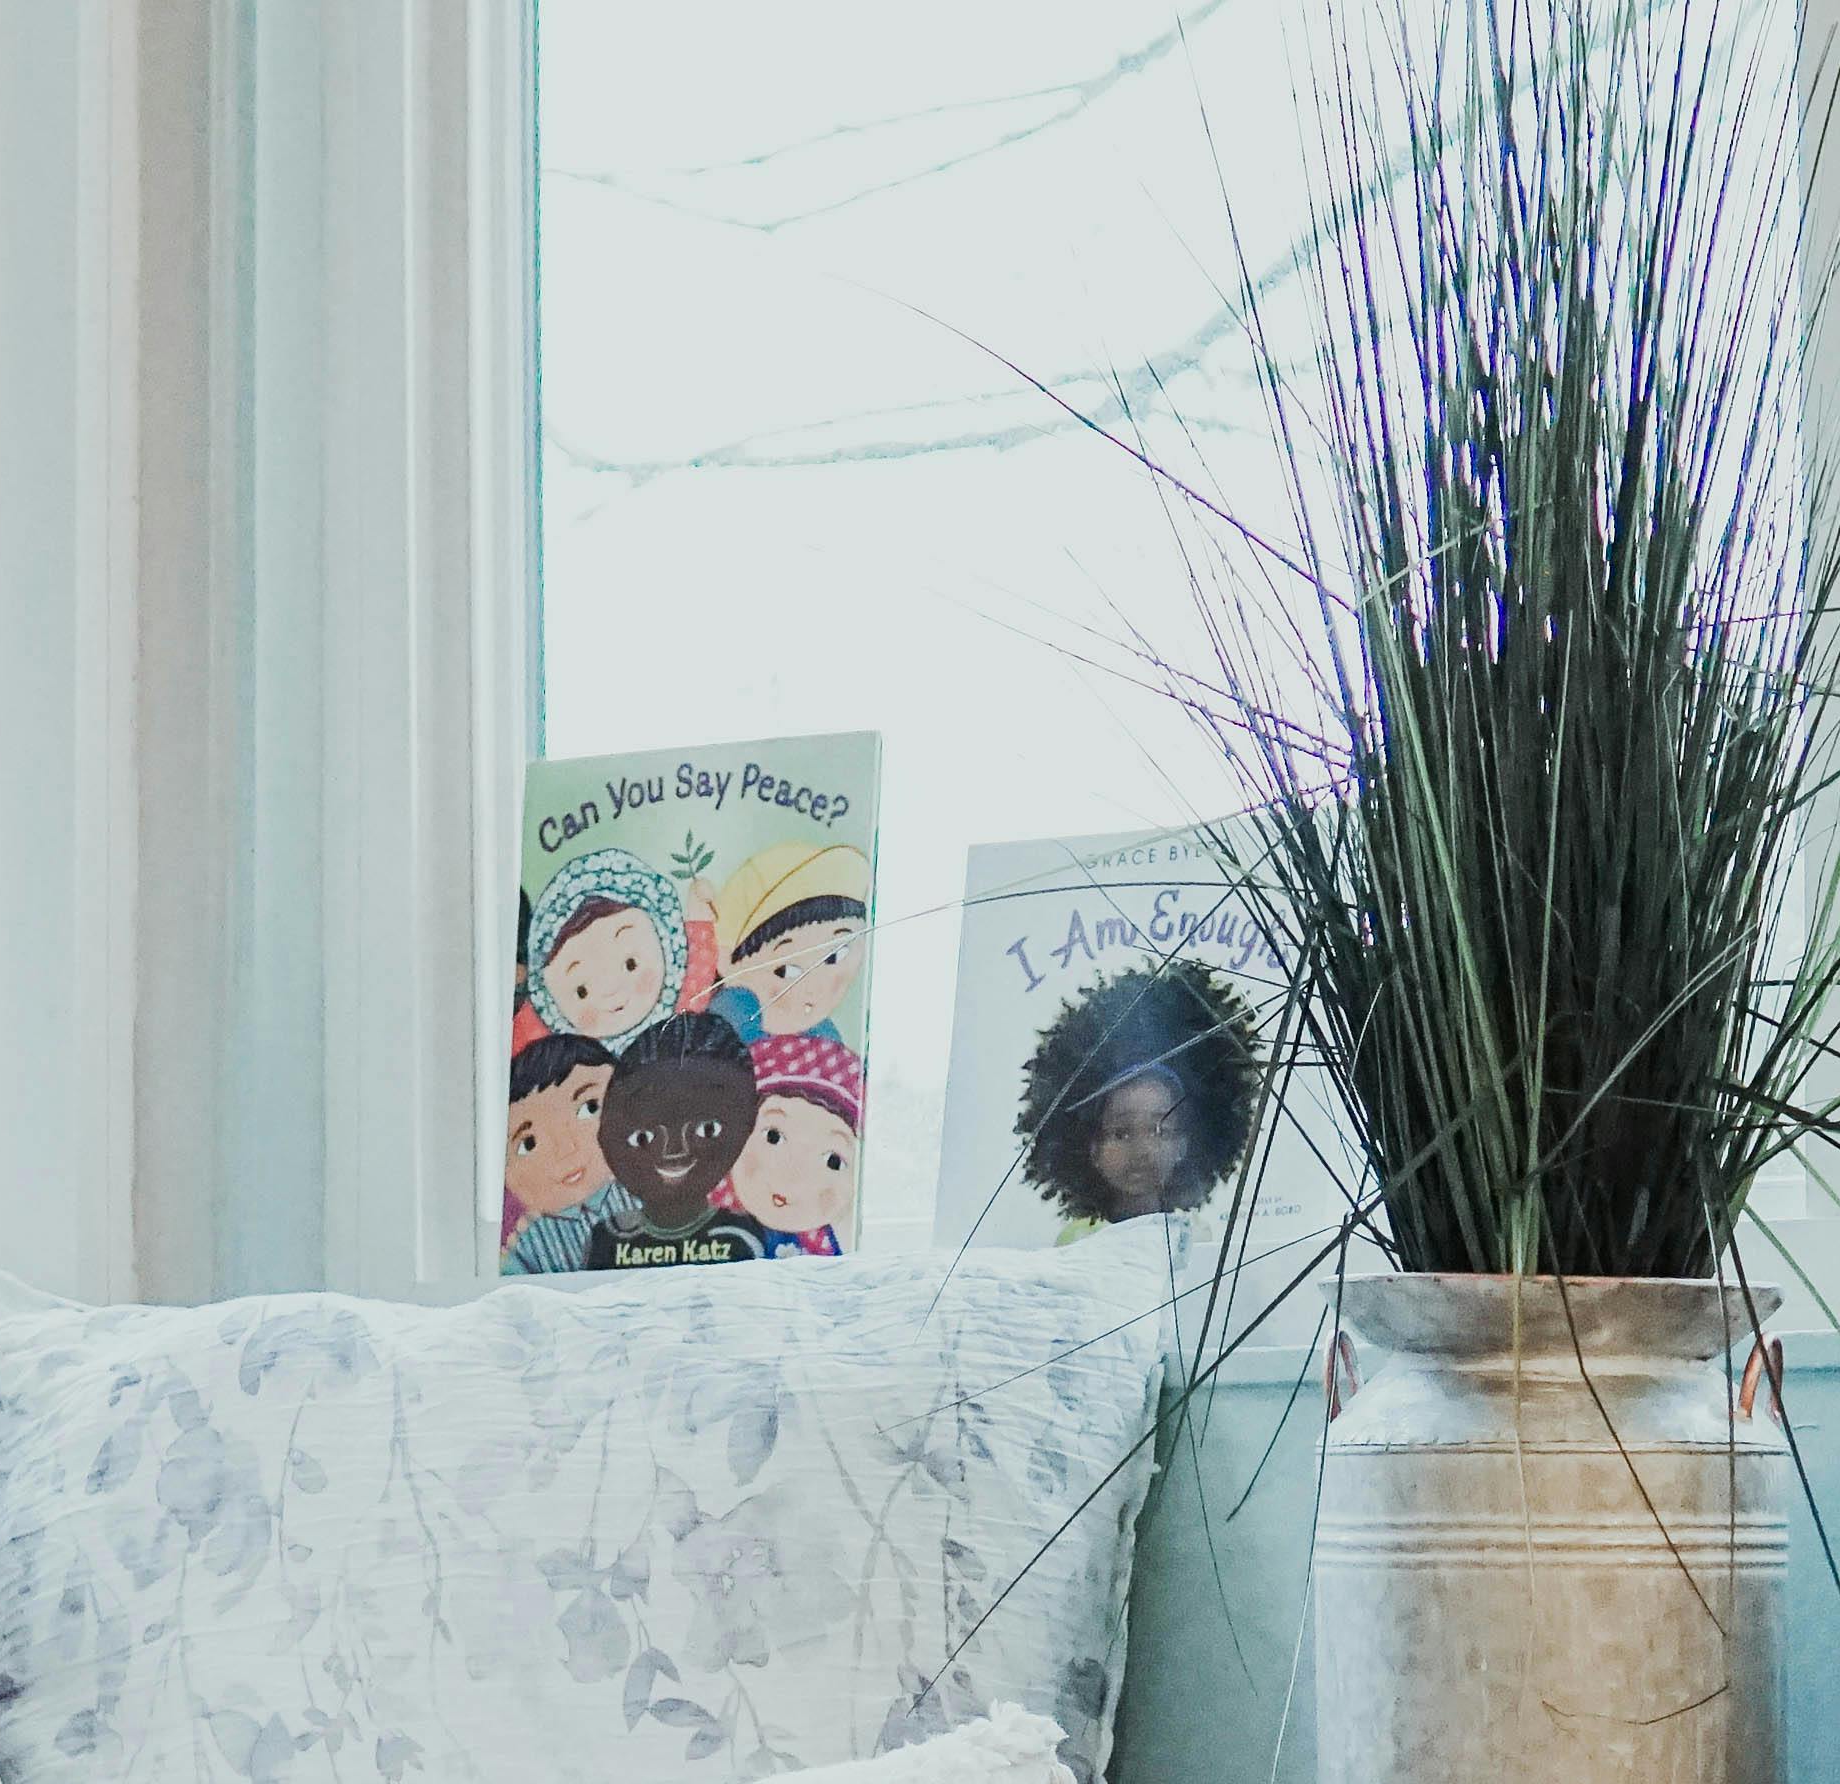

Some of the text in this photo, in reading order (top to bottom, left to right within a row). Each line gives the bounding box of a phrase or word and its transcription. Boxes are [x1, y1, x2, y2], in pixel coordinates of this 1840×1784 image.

[538, 762, 849, 852] Can You Say Peace?
[1005, 936, 1047, 993] I
[1050, 908, 1139, 969] Am
[615, 1239, 732, 1265] Karen Katz
